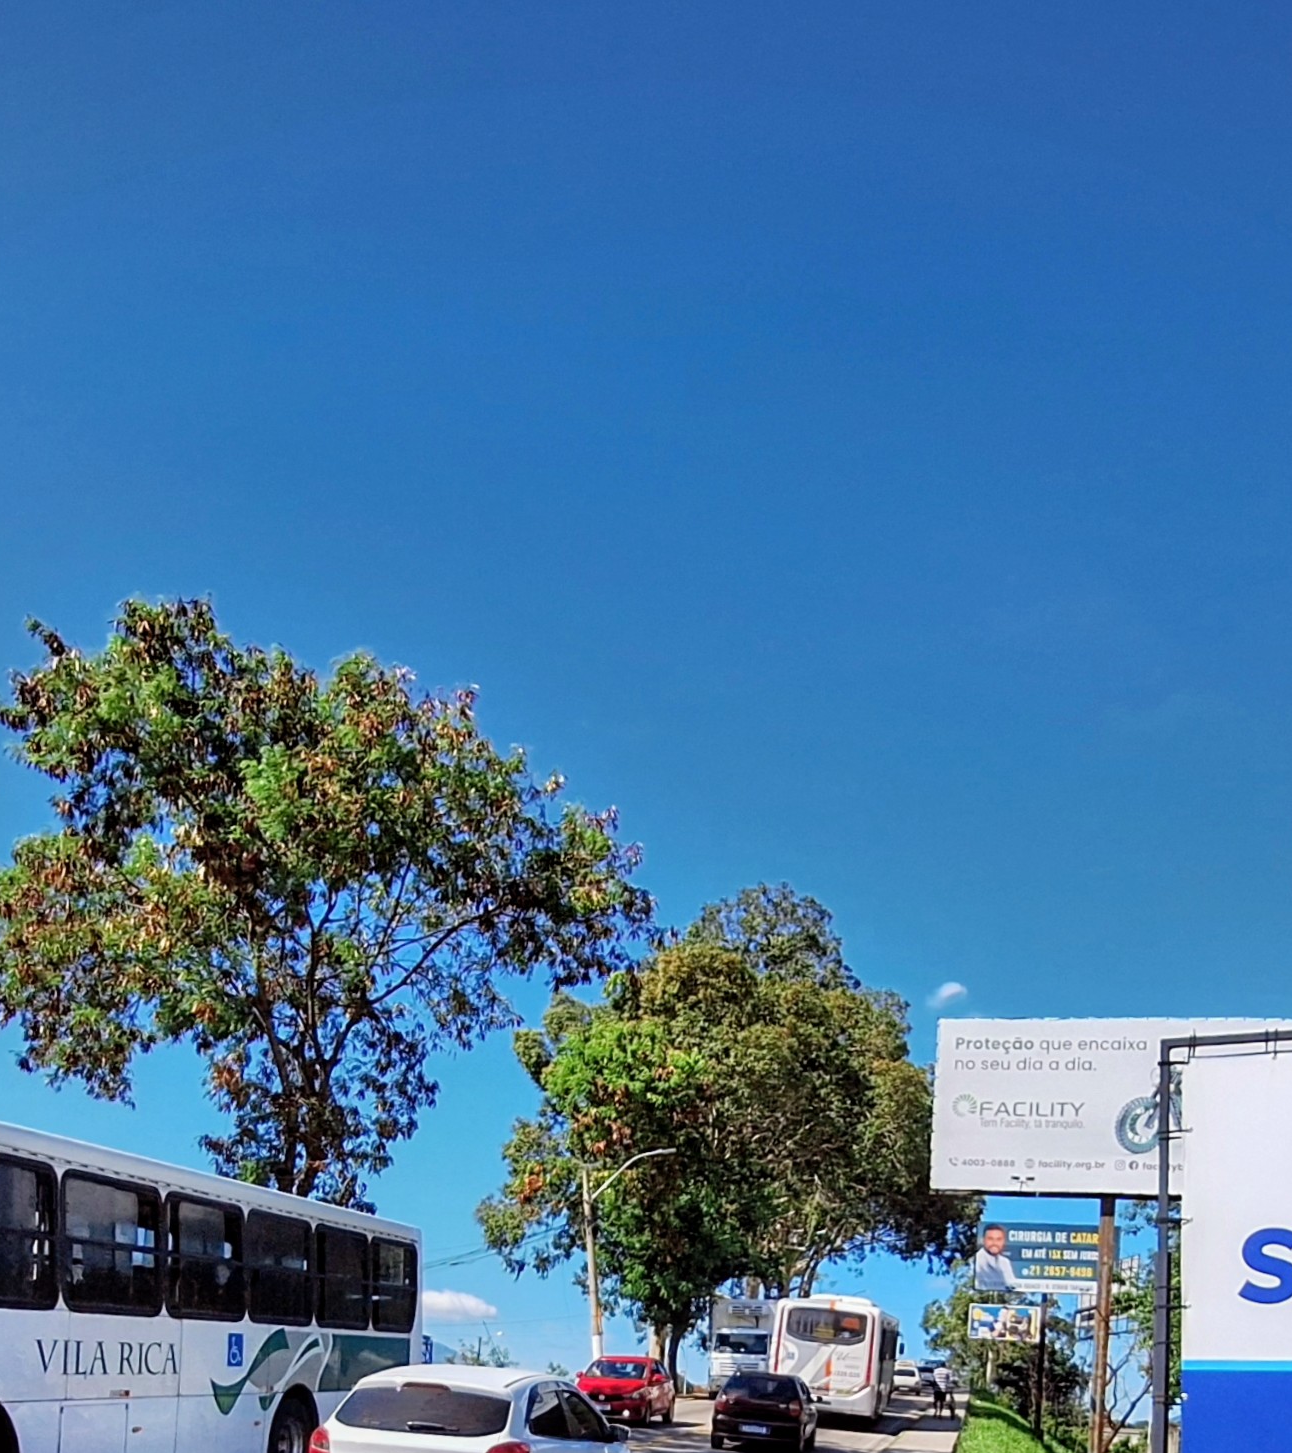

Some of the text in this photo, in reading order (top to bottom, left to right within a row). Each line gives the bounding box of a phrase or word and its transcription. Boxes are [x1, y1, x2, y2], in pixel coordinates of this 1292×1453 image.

[955, 1036, 1147, 1054] Proteção que encaixa
[954, 1057, 1097, 1071] no seu dia a dia.
[979, 1101, 1085, 1117] FACILITY
[980, 1117, 997, 1128] Tem
[961, 1158, 1015, 1167] 4003-0888
[1038, 1159, 1106, 1171] facility.org.br
[1008, 1230, 1099, 1244] CIRURGIA DE CATAR
[36, 1339, 180, 1376] VILA RICA
